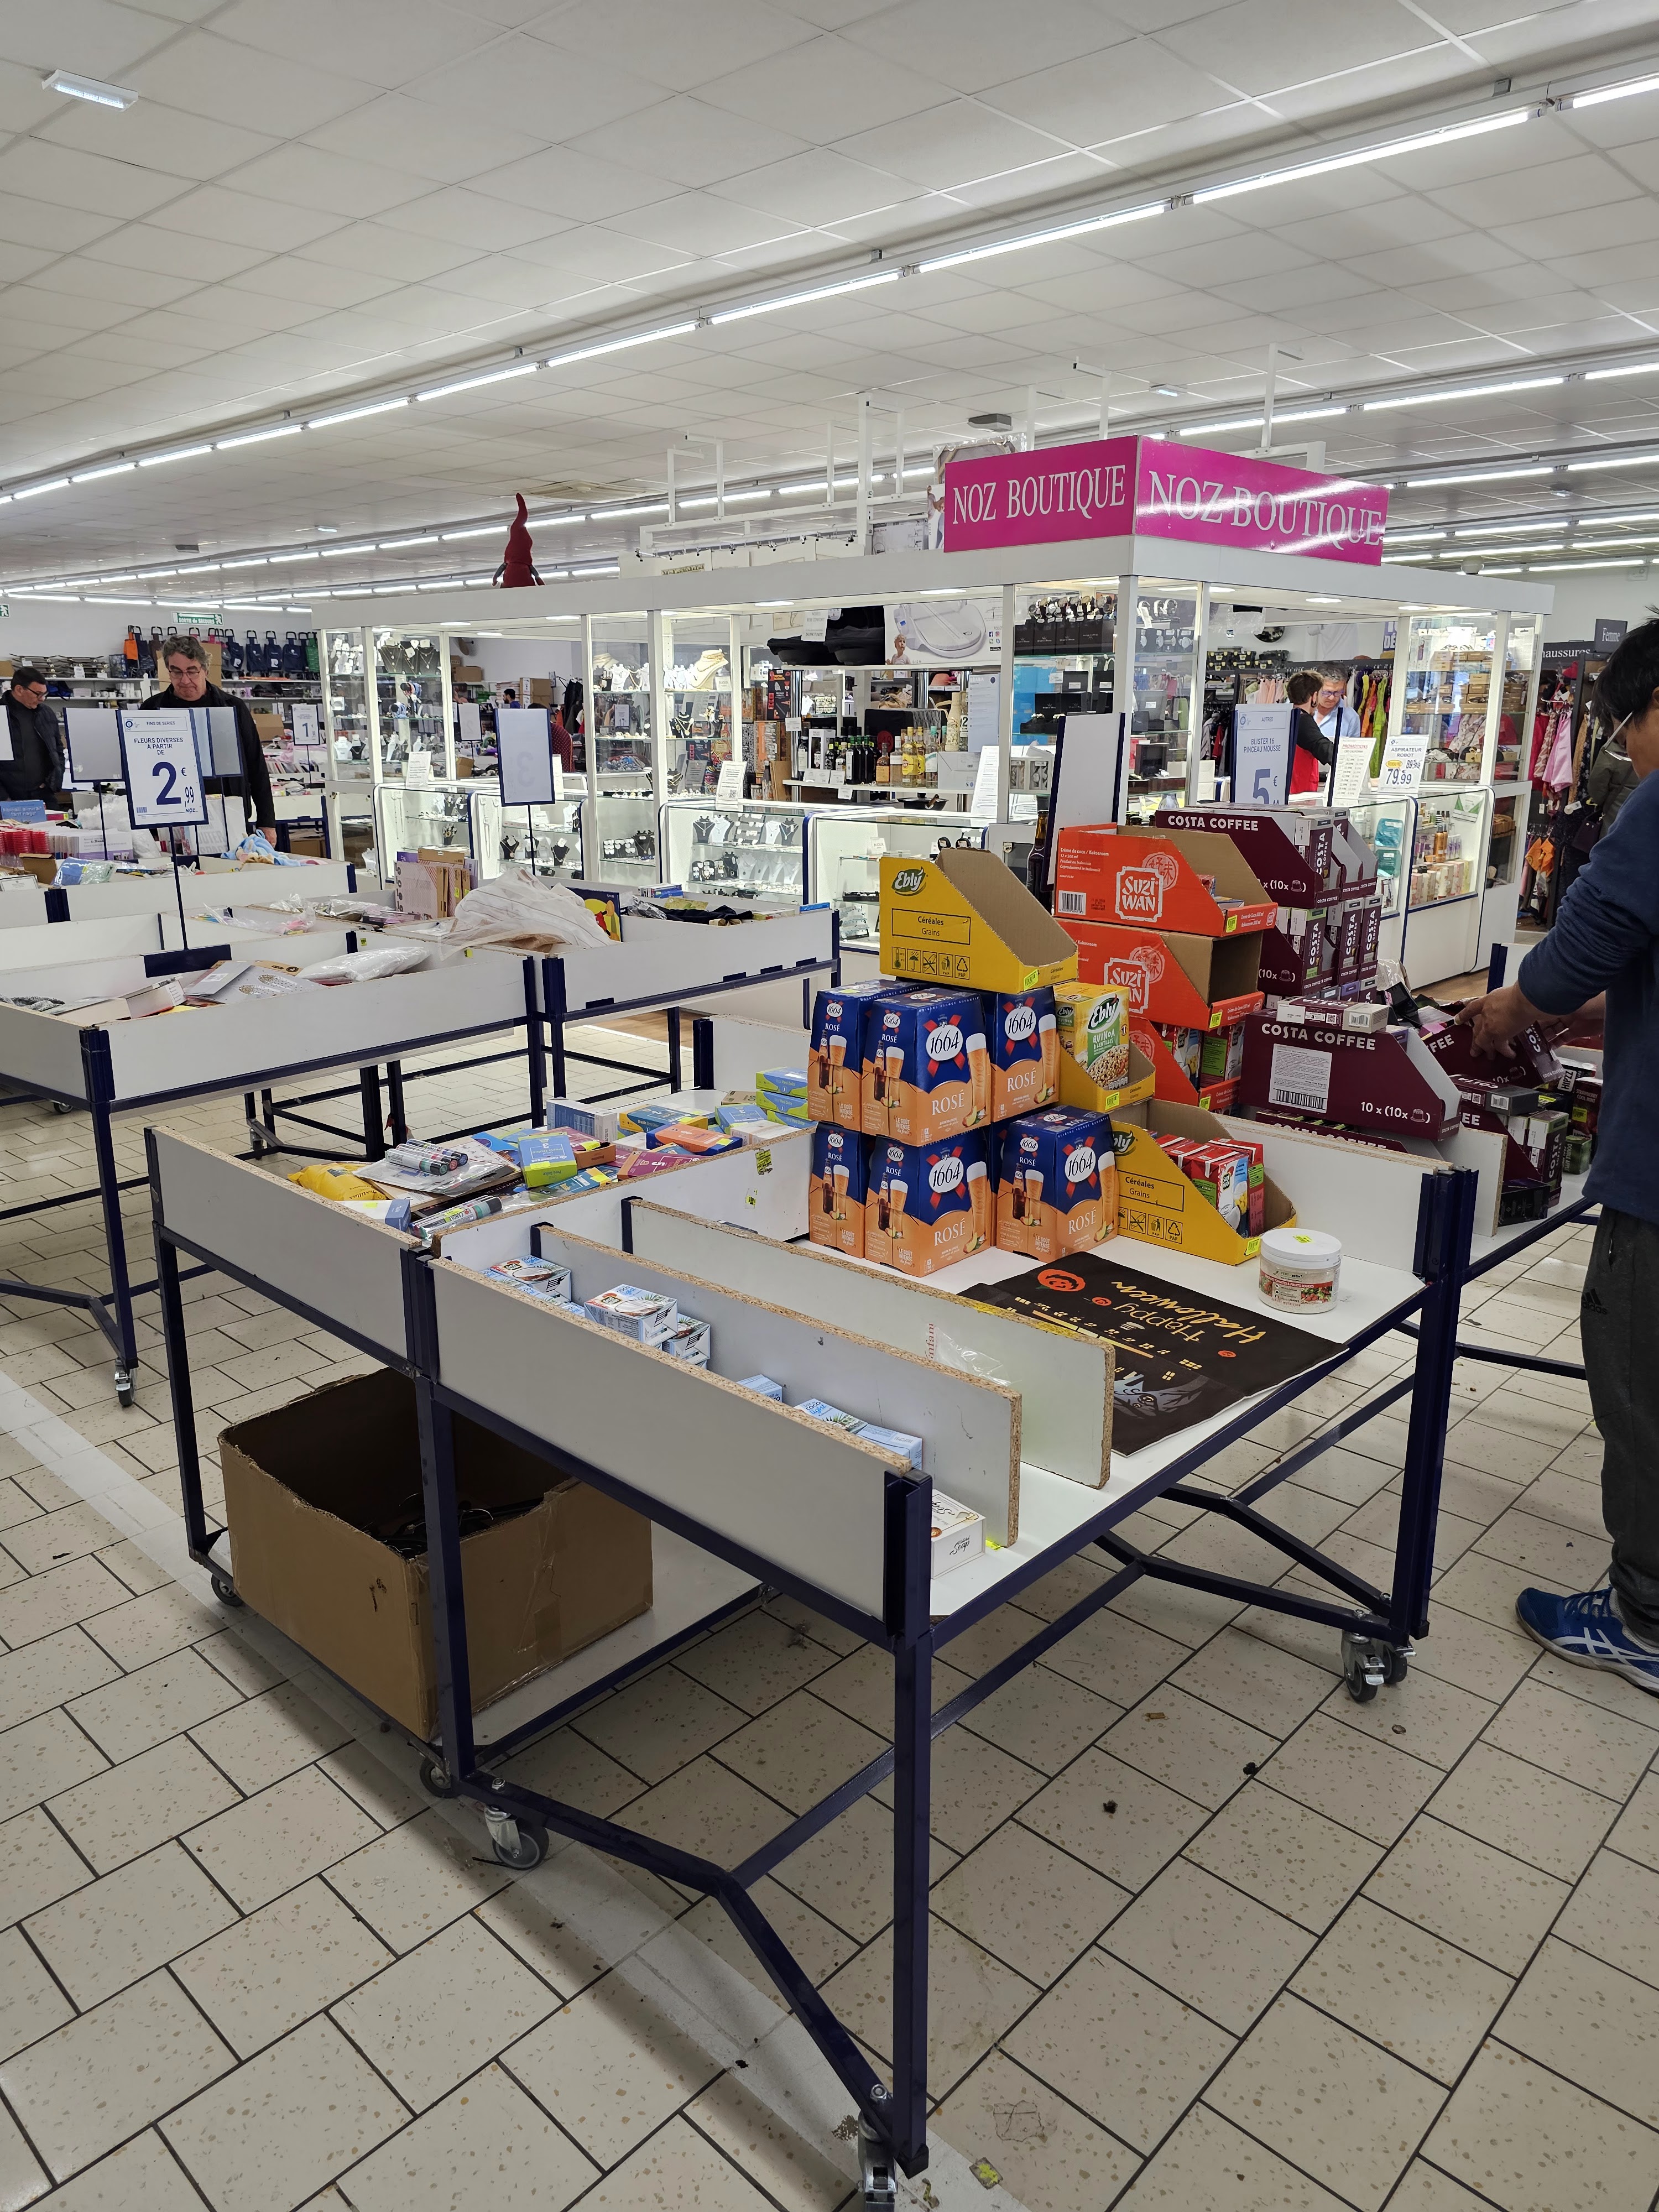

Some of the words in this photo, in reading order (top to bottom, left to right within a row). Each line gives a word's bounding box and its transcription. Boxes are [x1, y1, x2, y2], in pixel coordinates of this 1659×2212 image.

[953, 482, 997, 524] NOZ
[1006, 465, 1125, 519] BOUTIQUE
[1149, 471, 1224, 523] NOZ
[1230, 486, 1382, 550] BOUTIQUE
[1602, 628, 1620, 642] Femme
[1542, 649, 1590, 658] haussures
[302, 722, 309, 737] 1
[181, 768, 187, 776] €
[152, 761, 181, 805] 2
[1253, 769, 1270, 805] 5
[1274, 775, 1277, 786] €
[1168, 815, 1205, 827] COSTA
[1210, 818, 1259, 831] COFFEE
[1122, 895, 1156, 912] WAN
[918, 916, 944, 926] Céréales
[921, 927, 940, 937] Grains
[1346, 914, 1356, 955] COSTA
[1366, 910, 1375, 951] COSTA
[1310, 922, 1319, 965] COSTA
[827, 1005, 842, 1015] 1664
[1058, 1006, 1072, 1016] Ebly
[1091, 1001, 1118, 1028] Ebly
[825, 1022, 840, 1032] ROSÉ
[884, 1015, 899, 1025] 1664
[1008, 1011, 1034, 1035] 1664
[881, 1033, 897, 1044] ROSÉ
[930, 1030, 959, 1054] 1664
[1093, 1029, 1115, 1044] QUINOA
[1097, 1039, 1113, 1048] LENTILLES
[1261, 1023, 1308, 1040] COSTA
[1314, 1031, 1376, 1050] COFFEE
[1007, 1067, 1036, 1093] ROSÉ
[1561, 1071, 1574, 1091] HIPZZ
[1576, 1089, 1598, 1098] STRAWBERRY
[932, 1089, 965, 1116] ROSÉ
[1361, 1102, 1373, 1113] 10
[829, 1136, 843, 1145] 1664
[1021, 1137, 1037, 1149] 1664
[828, 1152, 842, 1161] ROSÉ
[888, 1149, 902, 1160] 1664
[1020, 1156, 1036, 1167] ROSÉ
[1549, 1134, 1560, 1178] COSTA
[1068, 1151, 1093, 1177] 1664
[886, 1166, 901, 1177] ROSÉ
[932, 1163, 961, 1188] 1664
[1125, 1176, 1155, 1190] Céréales
[1129, 1188, 1150, 1199] Grains
[444, 1209, 465, 1223] CANDLE
[1068, 1207, 1097, 1235] ROSÉ
[934, 1218, 966, 1246] ROSÉ
[1035, 1240, 1050, 1249] INTENSE
[899, 1253, 913, 1261] INTENSE
[1111, 1281, 1266, 1344] Halloween
[1113, 1302, 1206, 1343] Happy
[809, 1404, 827, 1415] light
[950, 1539, 971, 1556] Soap
